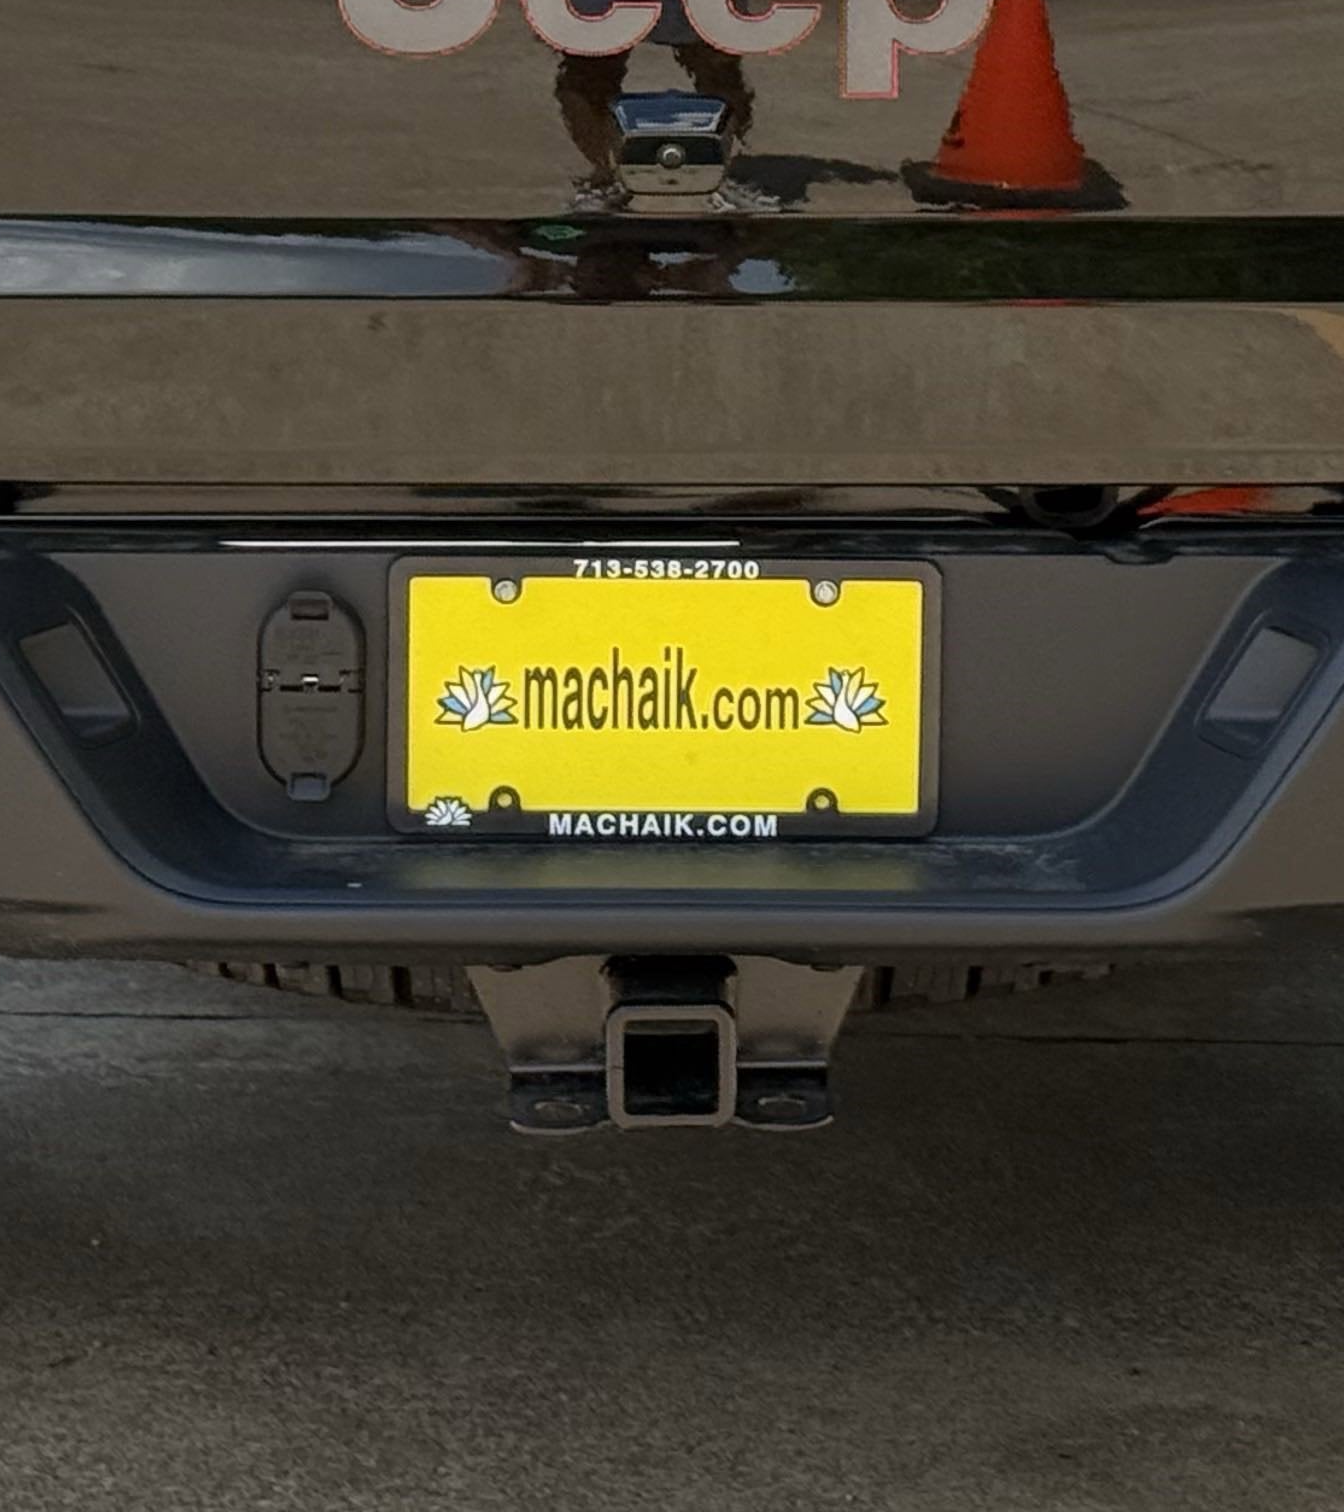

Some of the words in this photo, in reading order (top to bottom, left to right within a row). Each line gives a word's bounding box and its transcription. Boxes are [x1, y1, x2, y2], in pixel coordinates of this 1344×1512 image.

[572, 559, 760, 580] 713-538-2700
[522, 646, 800, 731] machaik.com
[548, 813, 778, 838] MACHAIK.COM
